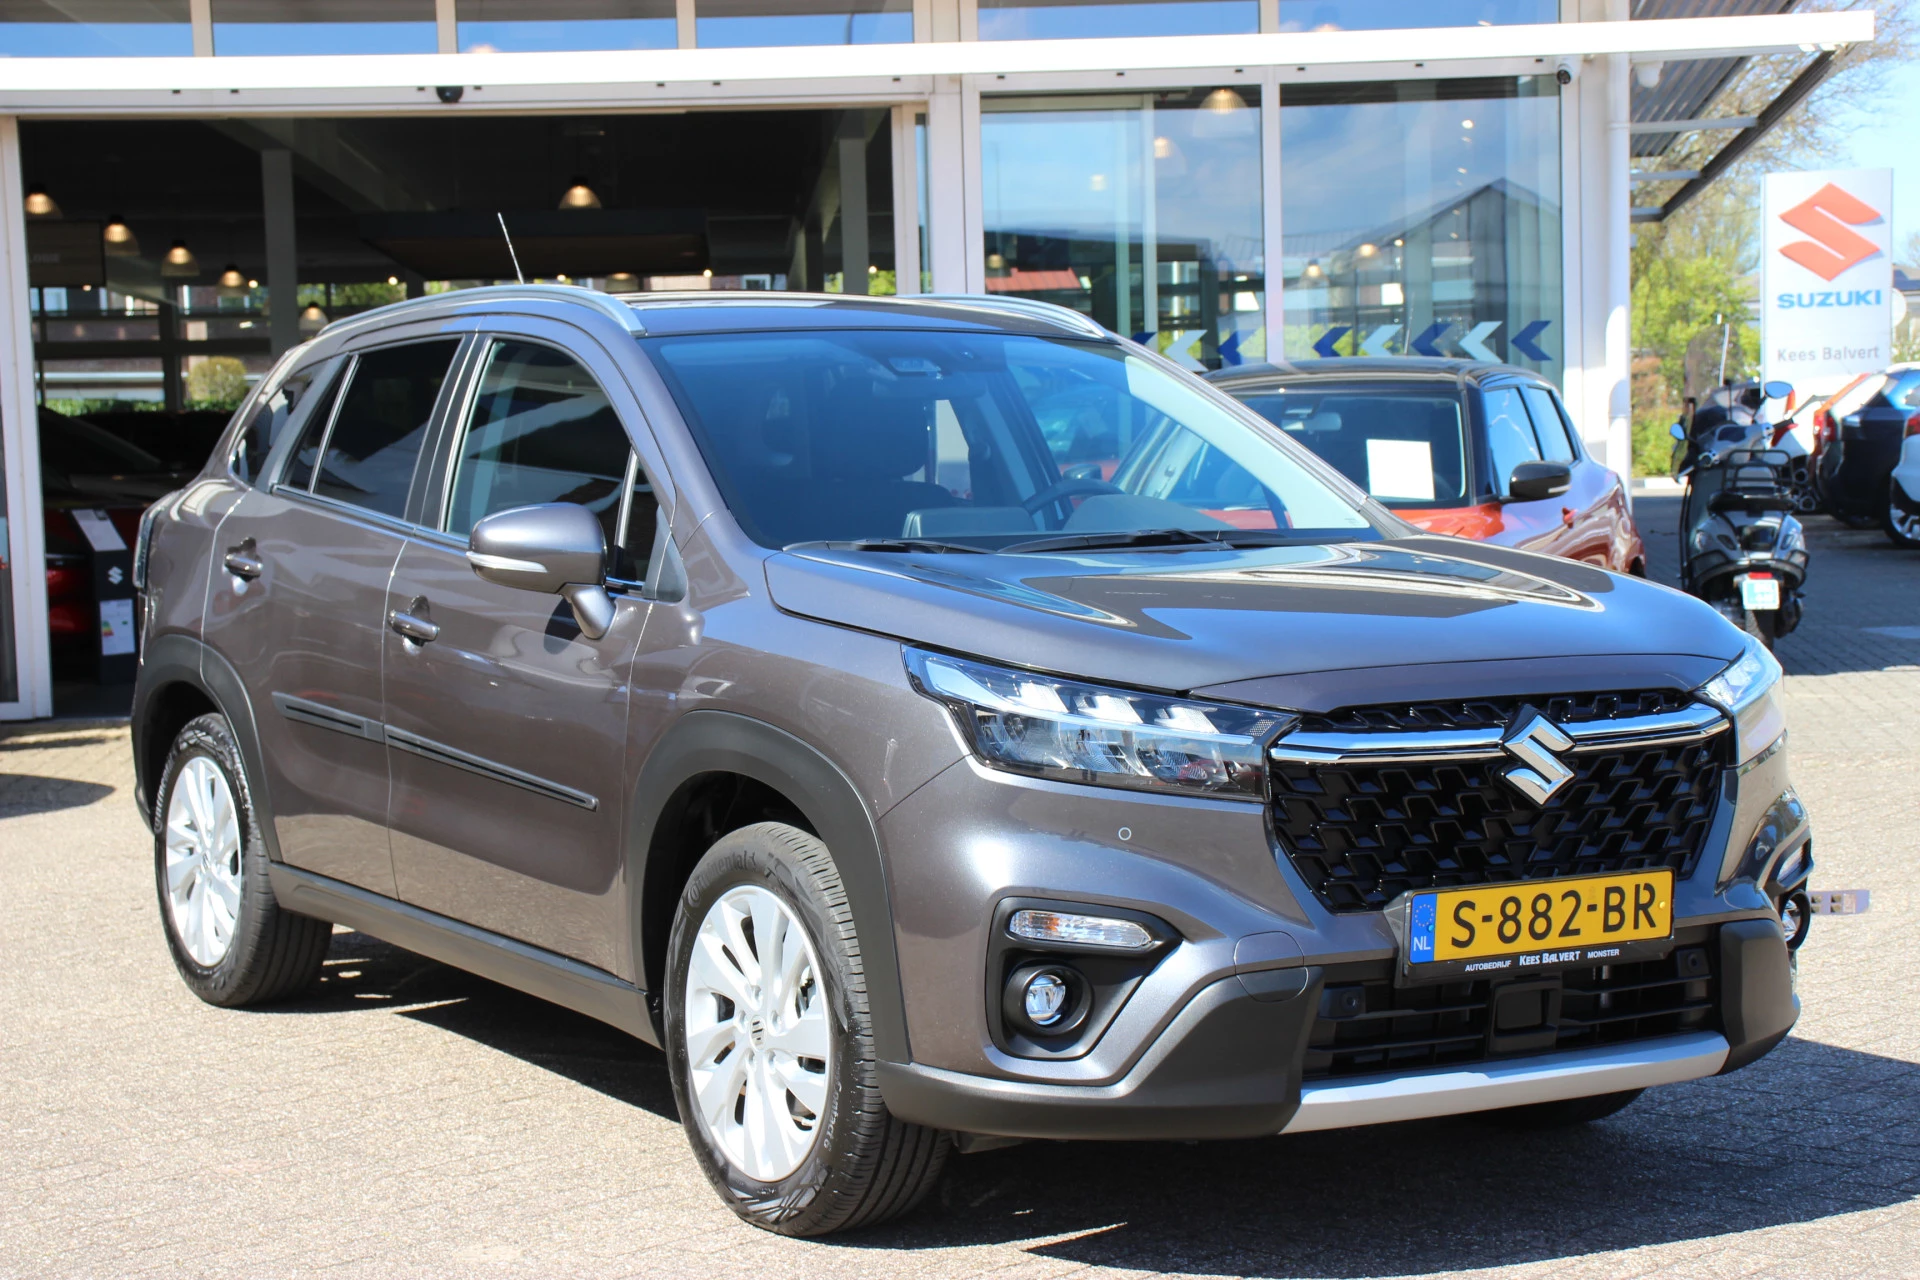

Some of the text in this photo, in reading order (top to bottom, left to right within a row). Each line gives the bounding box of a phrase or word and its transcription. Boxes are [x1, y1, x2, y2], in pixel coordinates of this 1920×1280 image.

[1777, 290, 1882, 308] SUZUKI
[1777, 346, 1879, 362] Kees Balvert
[1451, 882, 1657, 949] S-882-BR
[1413, 936, 1431, 951] NL
[1465, 949, 1620, 972] AUTOBEDRIJF KEES BALVERT MONSTER
